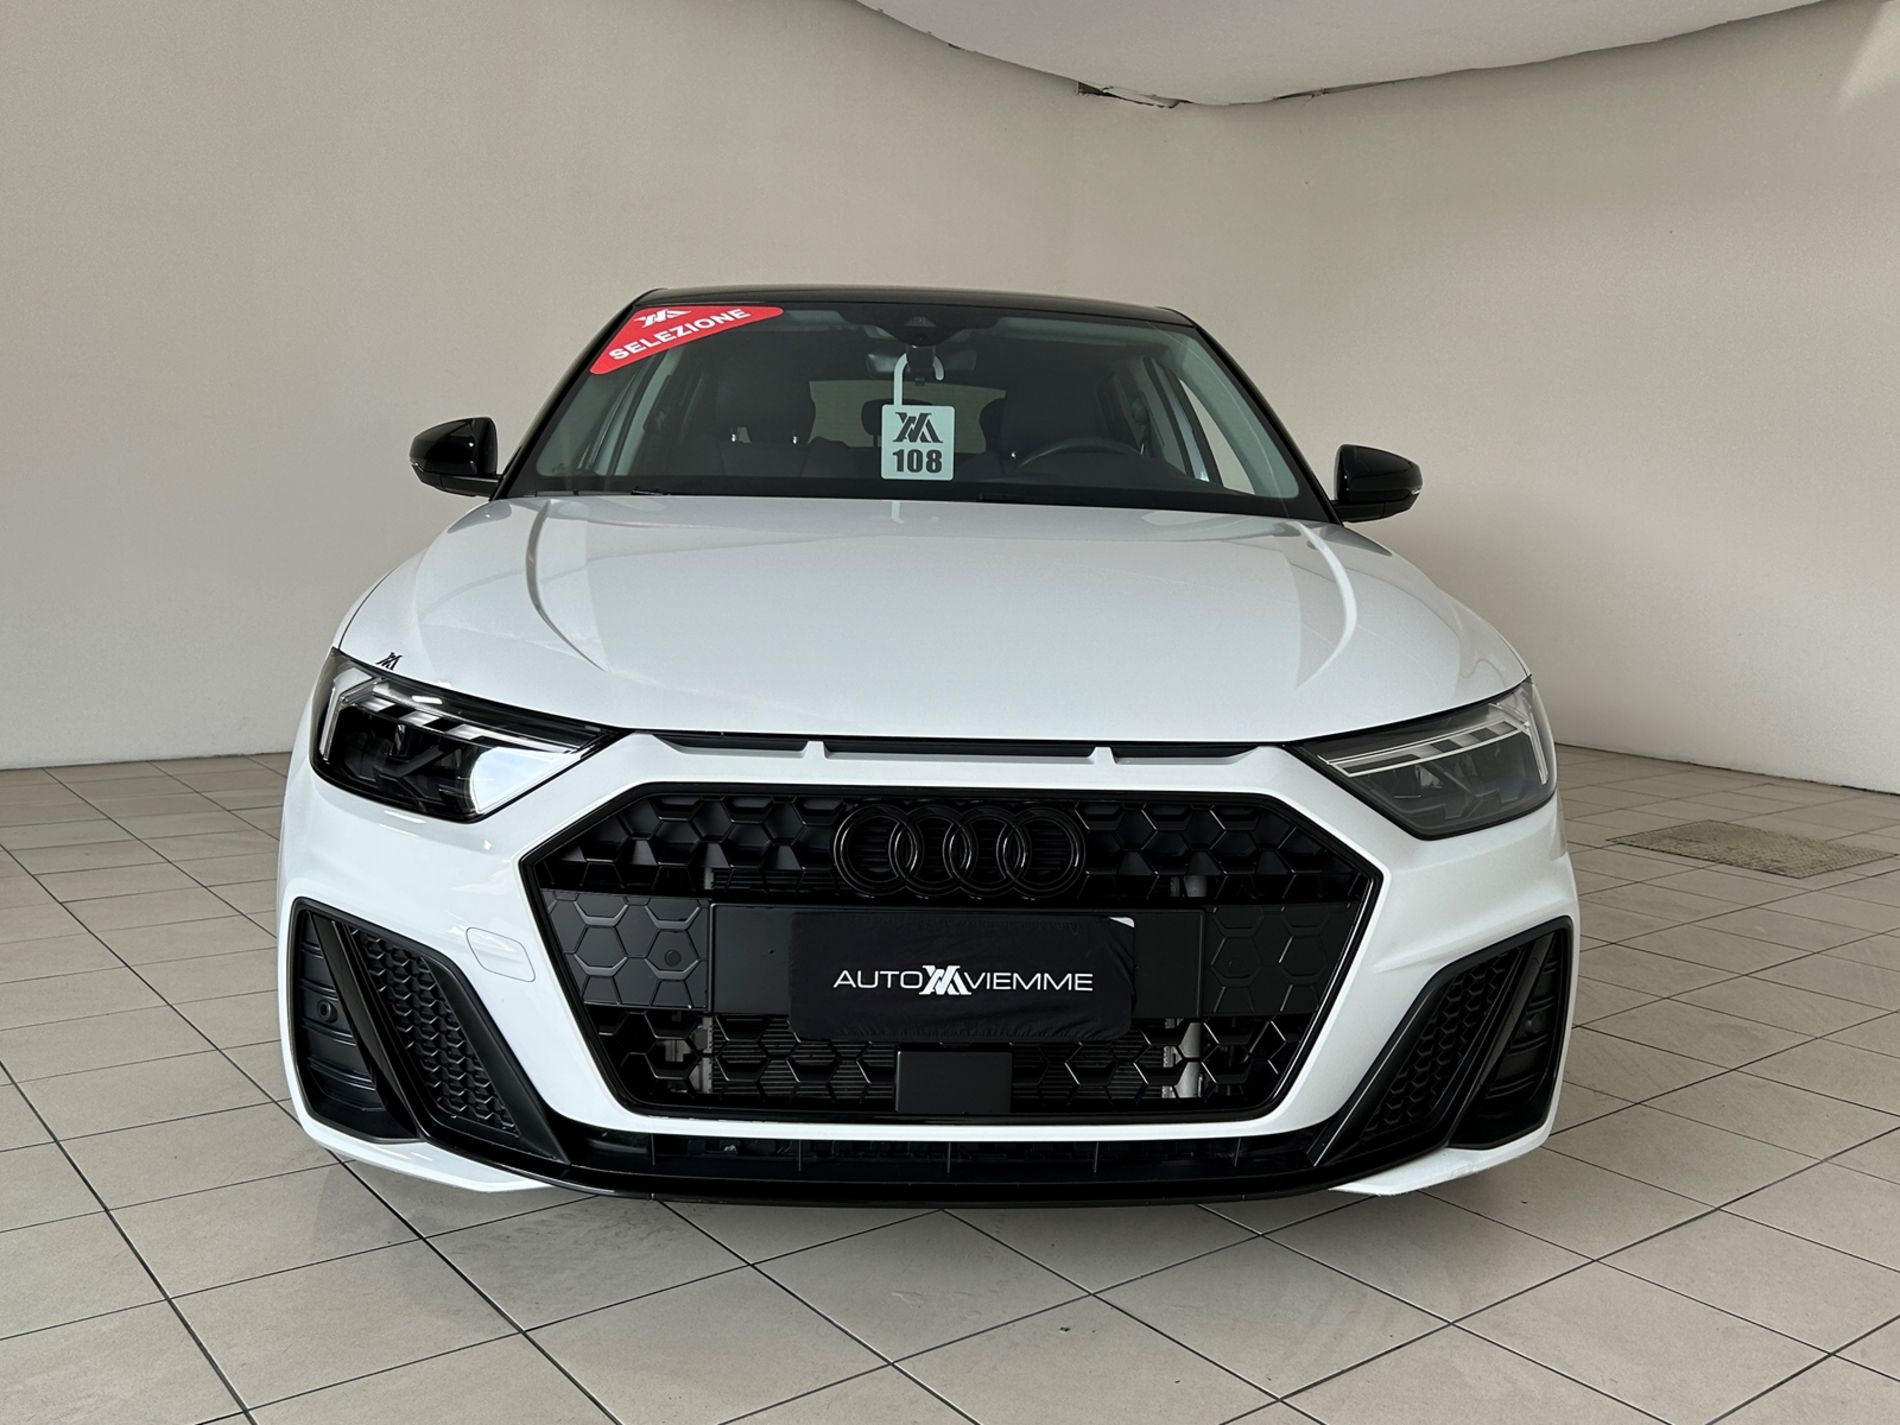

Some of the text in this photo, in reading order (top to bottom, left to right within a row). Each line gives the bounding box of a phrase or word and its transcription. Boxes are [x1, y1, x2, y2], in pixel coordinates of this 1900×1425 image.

[608, 308, 751, 360] SELEZIONE
[892, 448, 943, 474] 108
[833, 969, 924, 989] AUTO
[963, 971, 1094, 992] VIEMME
